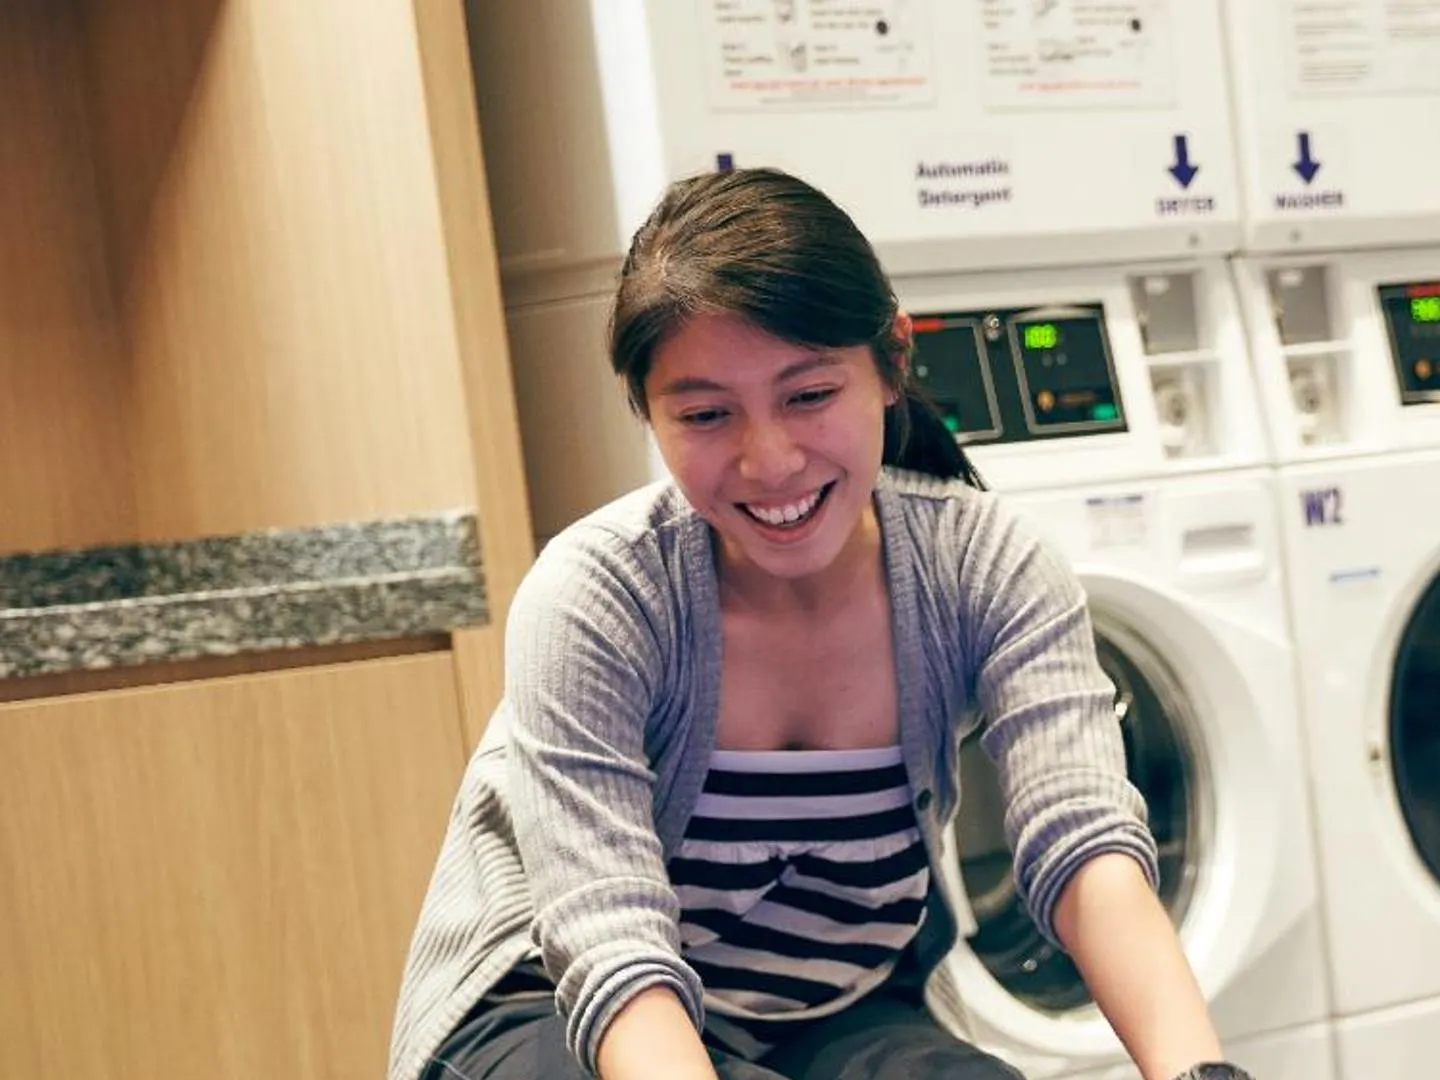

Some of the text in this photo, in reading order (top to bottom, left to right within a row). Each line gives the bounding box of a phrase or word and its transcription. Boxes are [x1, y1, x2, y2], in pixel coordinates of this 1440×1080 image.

[915, 158, 1010, 179] Automatic
[917, 186, 1011, 208] Detergent
[1298, 486, 1344, 528] W2
